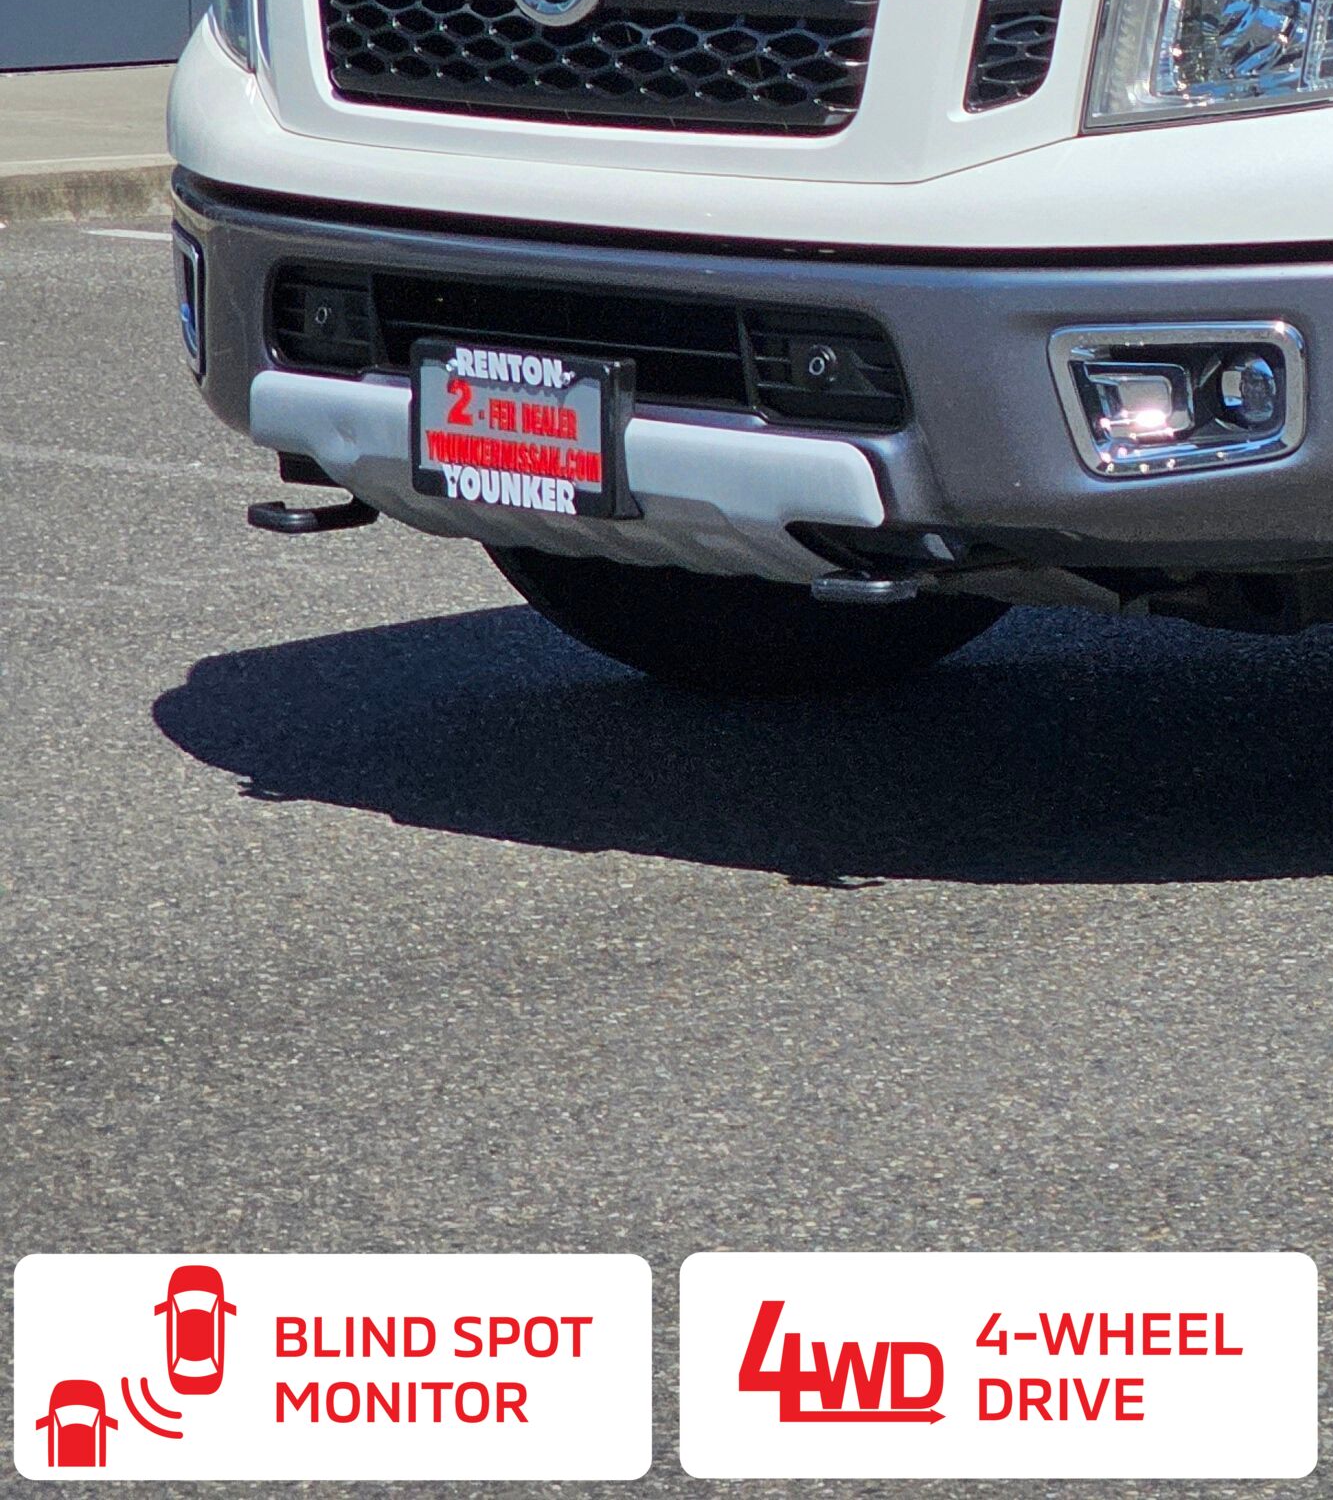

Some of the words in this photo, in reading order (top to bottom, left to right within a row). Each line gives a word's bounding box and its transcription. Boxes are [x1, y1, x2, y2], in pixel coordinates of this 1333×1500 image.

[455, 347, 563, 388] RENTON
[521, 403, 578, 441] DEALER
[442, 463, 577, 515] YOUNKER
